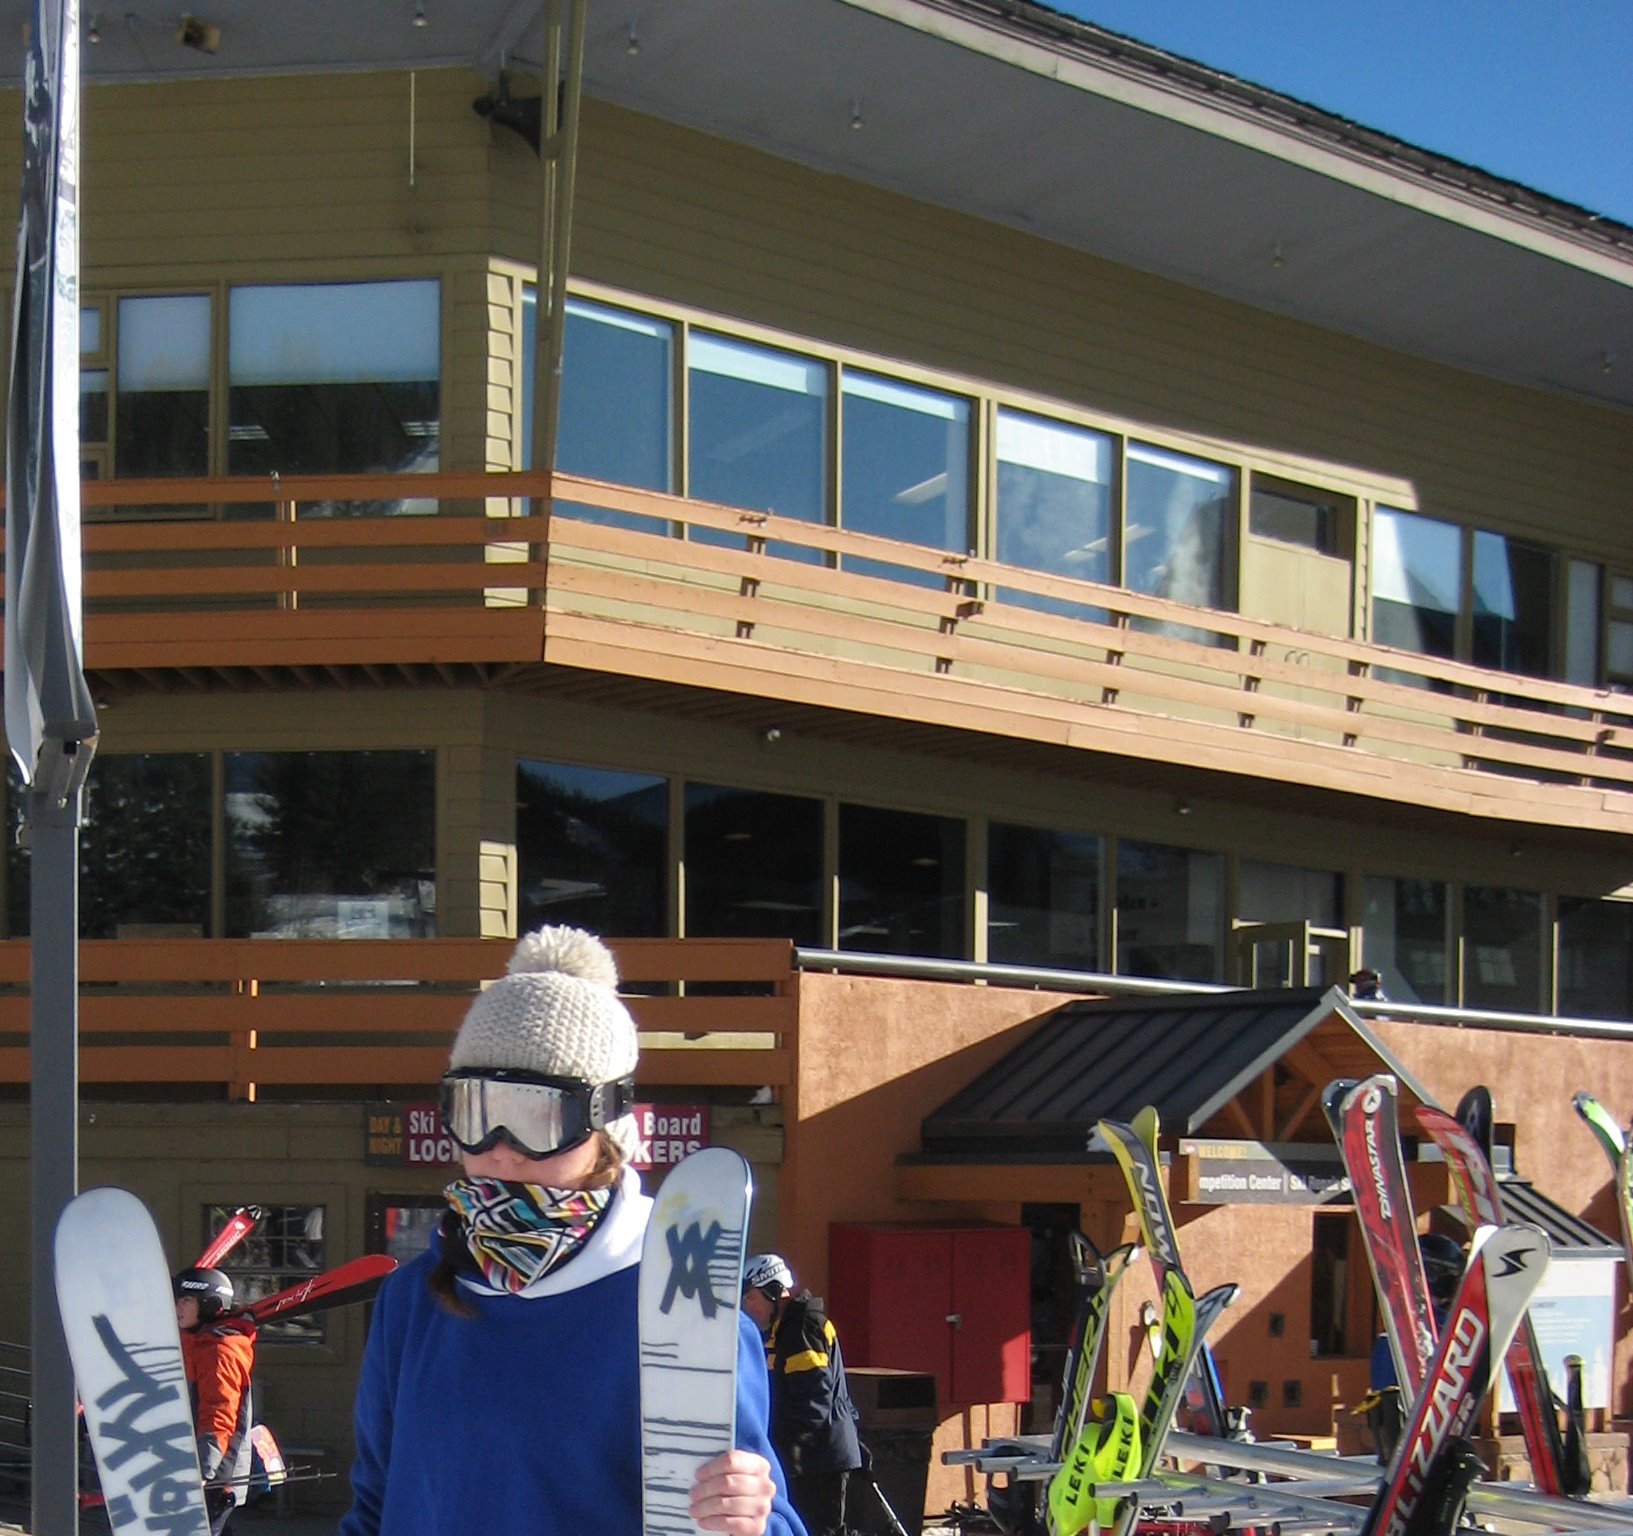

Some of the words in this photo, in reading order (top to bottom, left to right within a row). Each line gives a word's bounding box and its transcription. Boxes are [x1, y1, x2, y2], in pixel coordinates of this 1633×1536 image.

[409, 1110, 435, 1135] Ski
[643, 1111, 702, 1136] Board
[409, 1139, 451, 1162] LOC
[634, 1140, 702, 1163] KERS
[1364, 1118, 1392, 1220] DYNASTAR
[1199, 1173, 1247, 1193] mpetition
[1249, 1174, 1282, 1191] Center
[751, 1263, 788, 1285] SMITH
[1113, 1415, 1134, 1480] LEKI
[1065, 1443, 1091, 1507] LEKI
